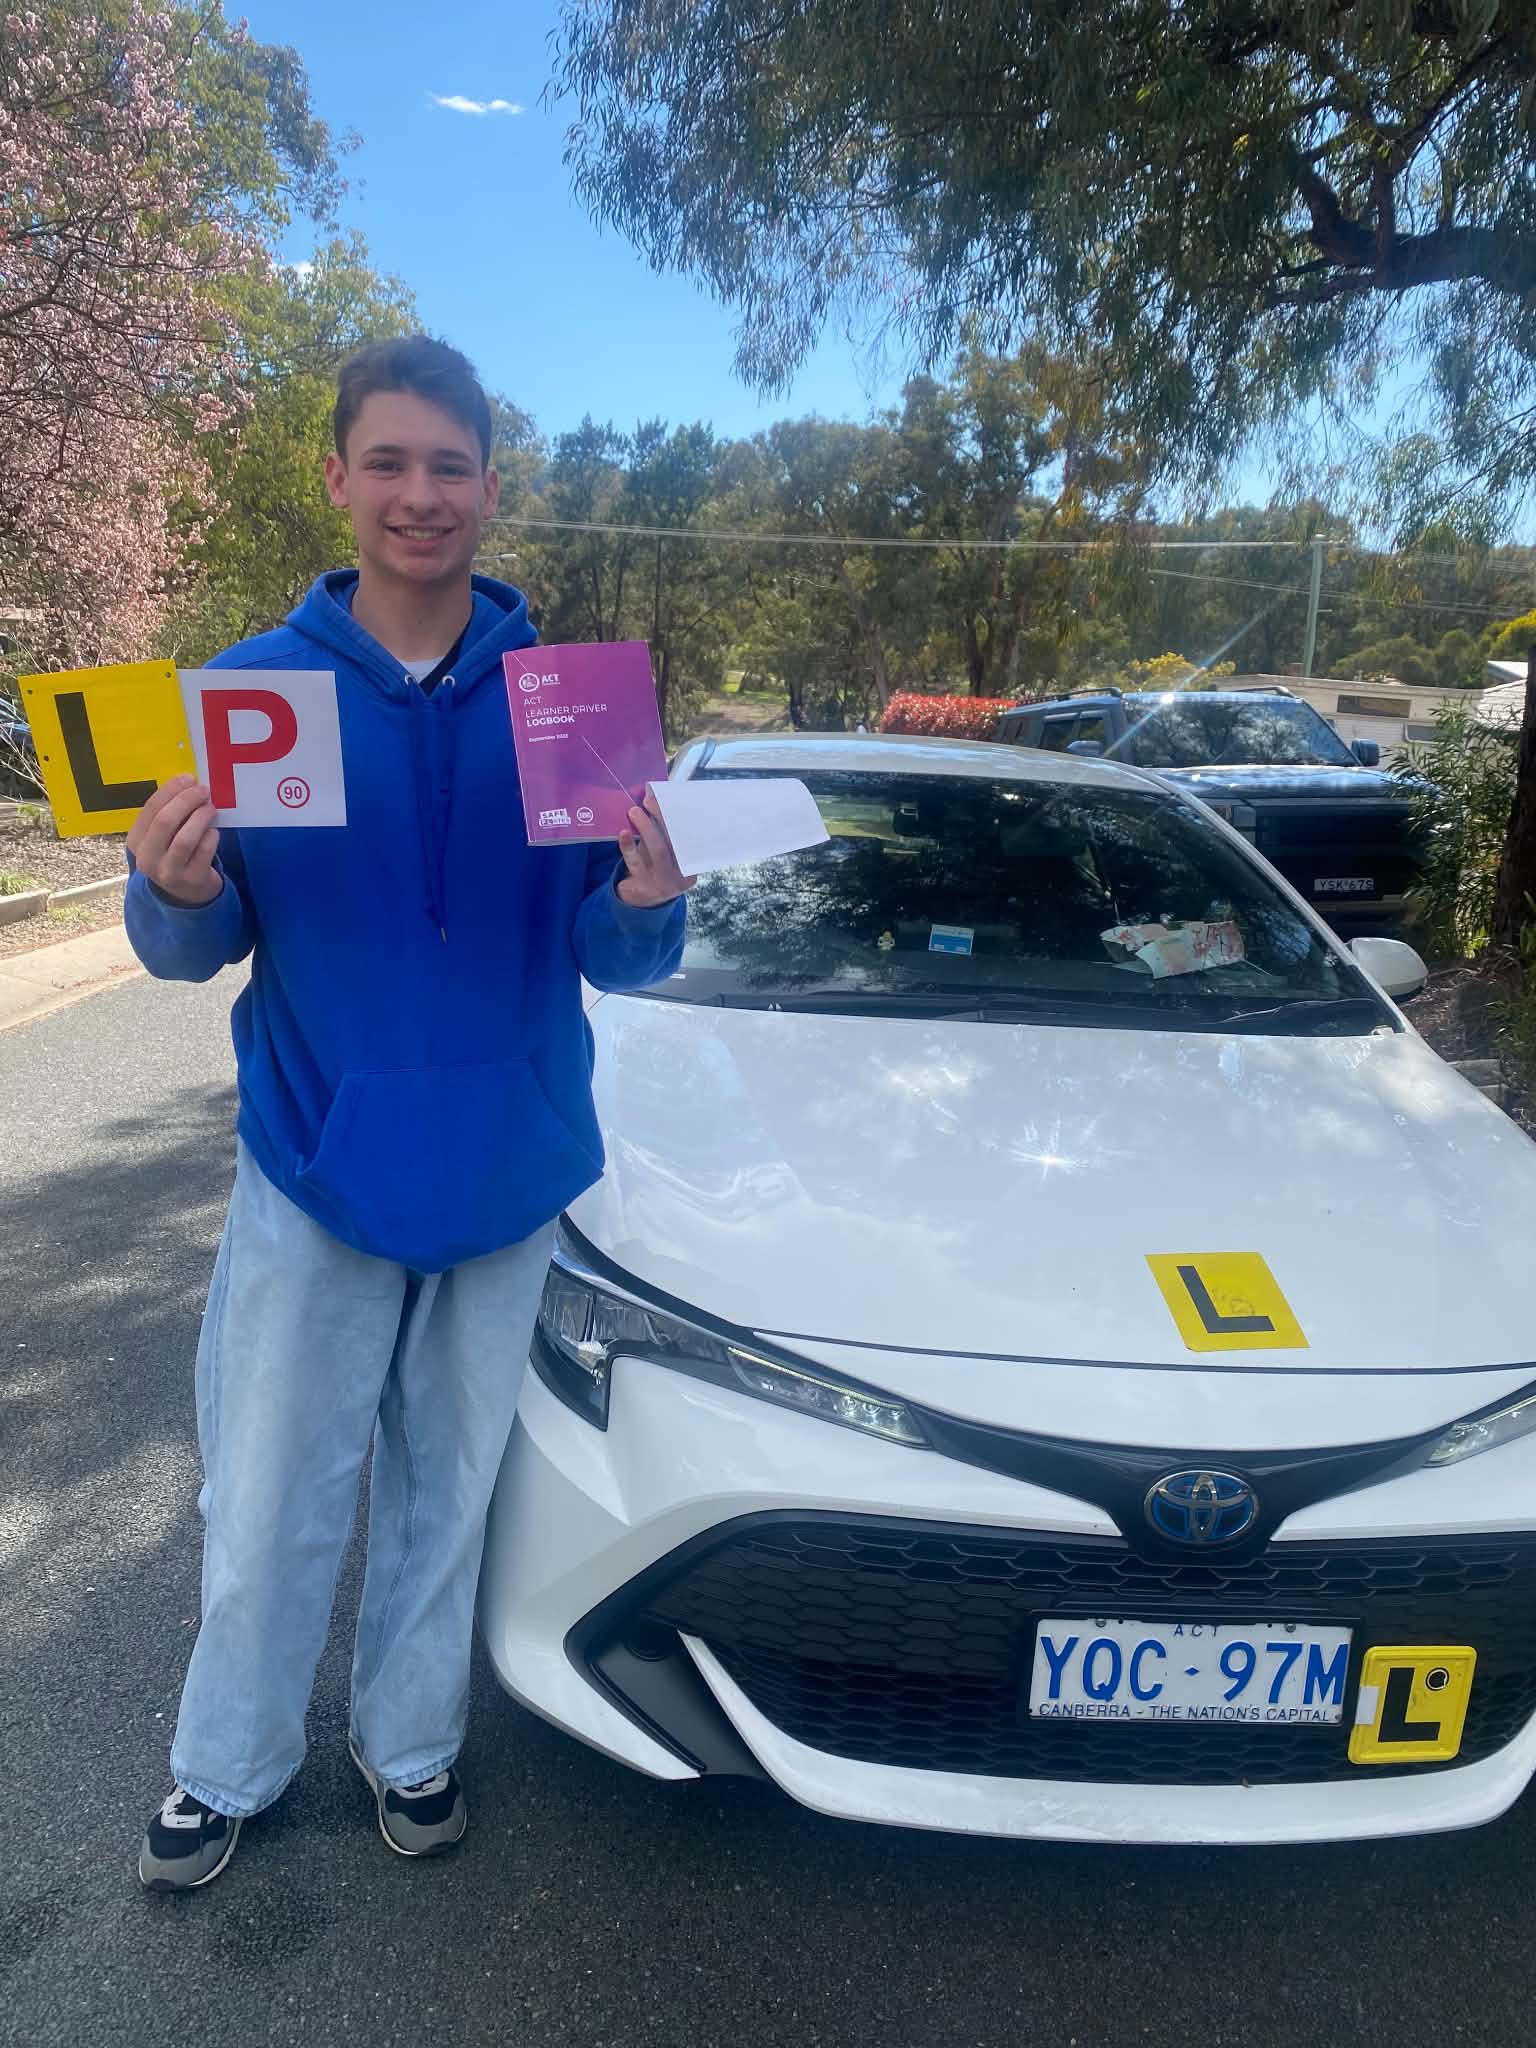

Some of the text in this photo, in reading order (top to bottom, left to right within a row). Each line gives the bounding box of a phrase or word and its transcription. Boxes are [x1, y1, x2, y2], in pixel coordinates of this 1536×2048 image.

[541, 673, 560, 683] ACT
[524, 696, 541, 706] ACT
[525, 703, 607, 719] LEARNER DRIVER
[526, 714, 576, 727] LOGBOOK
[54, 692, 158, 813] L
[200, 689, 298, 809] P
[284, 786, 302, 799] 90
[1176, 1265, 1276, 1333] L
[1173, 1623, 1222, 1637] ACT
[1039, 1703, 1131, 1718] CANBERRA
[1149, 1705, 1181, 1719] THE
[1187, 1706, 1260, 1721] NATION'S
[1266, 1708, 1330, 1722] CAPITAL
[1377, 1667, 1441, 1743] L
